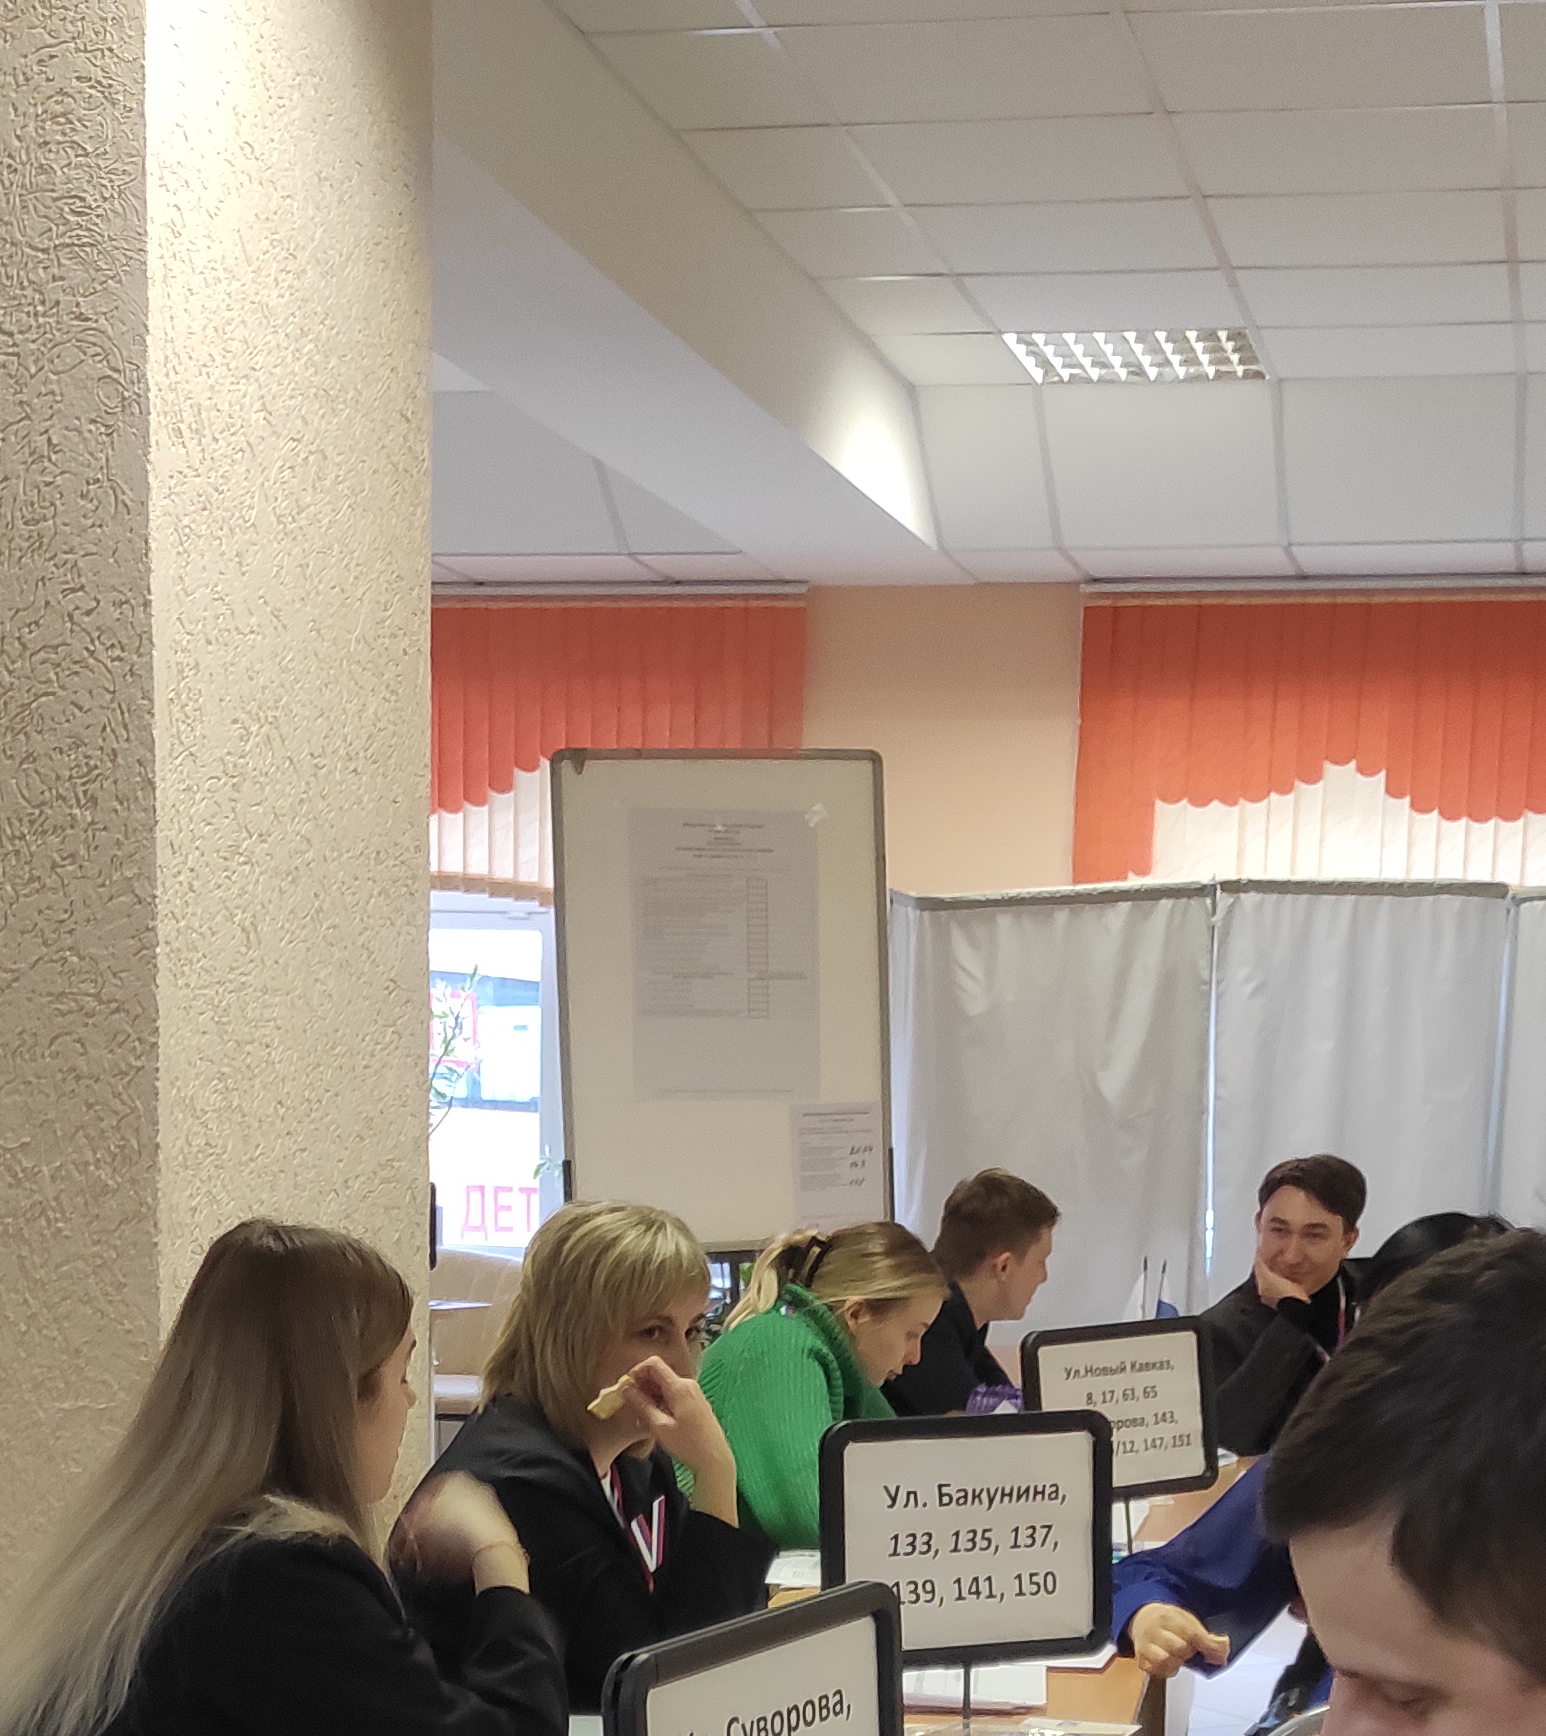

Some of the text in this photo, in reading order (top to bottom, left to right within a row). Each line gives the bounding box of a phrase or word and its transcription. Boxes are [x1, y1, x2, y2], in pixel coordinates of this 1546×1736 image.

[1130, 1359, 1175, 1375] Кавказ,
[1086, 1392, 1097, 1407] 8,
[1101, 1389, 1119, 1405] 17,
[1110, 1410, 1178, 1432] орова, 143,
[1143, 1436, 1168, 1452] 147,
[1171, 1433, 1192, 1448] 151
[883, 1482, 1067, 1511] Ул. Бакунина,
[887, 1524, 1059, 1560] 133, 135, 137,
[953, 1575, 1005, 1603] 141,
[1013, 1570, 1058, 1597] 150
